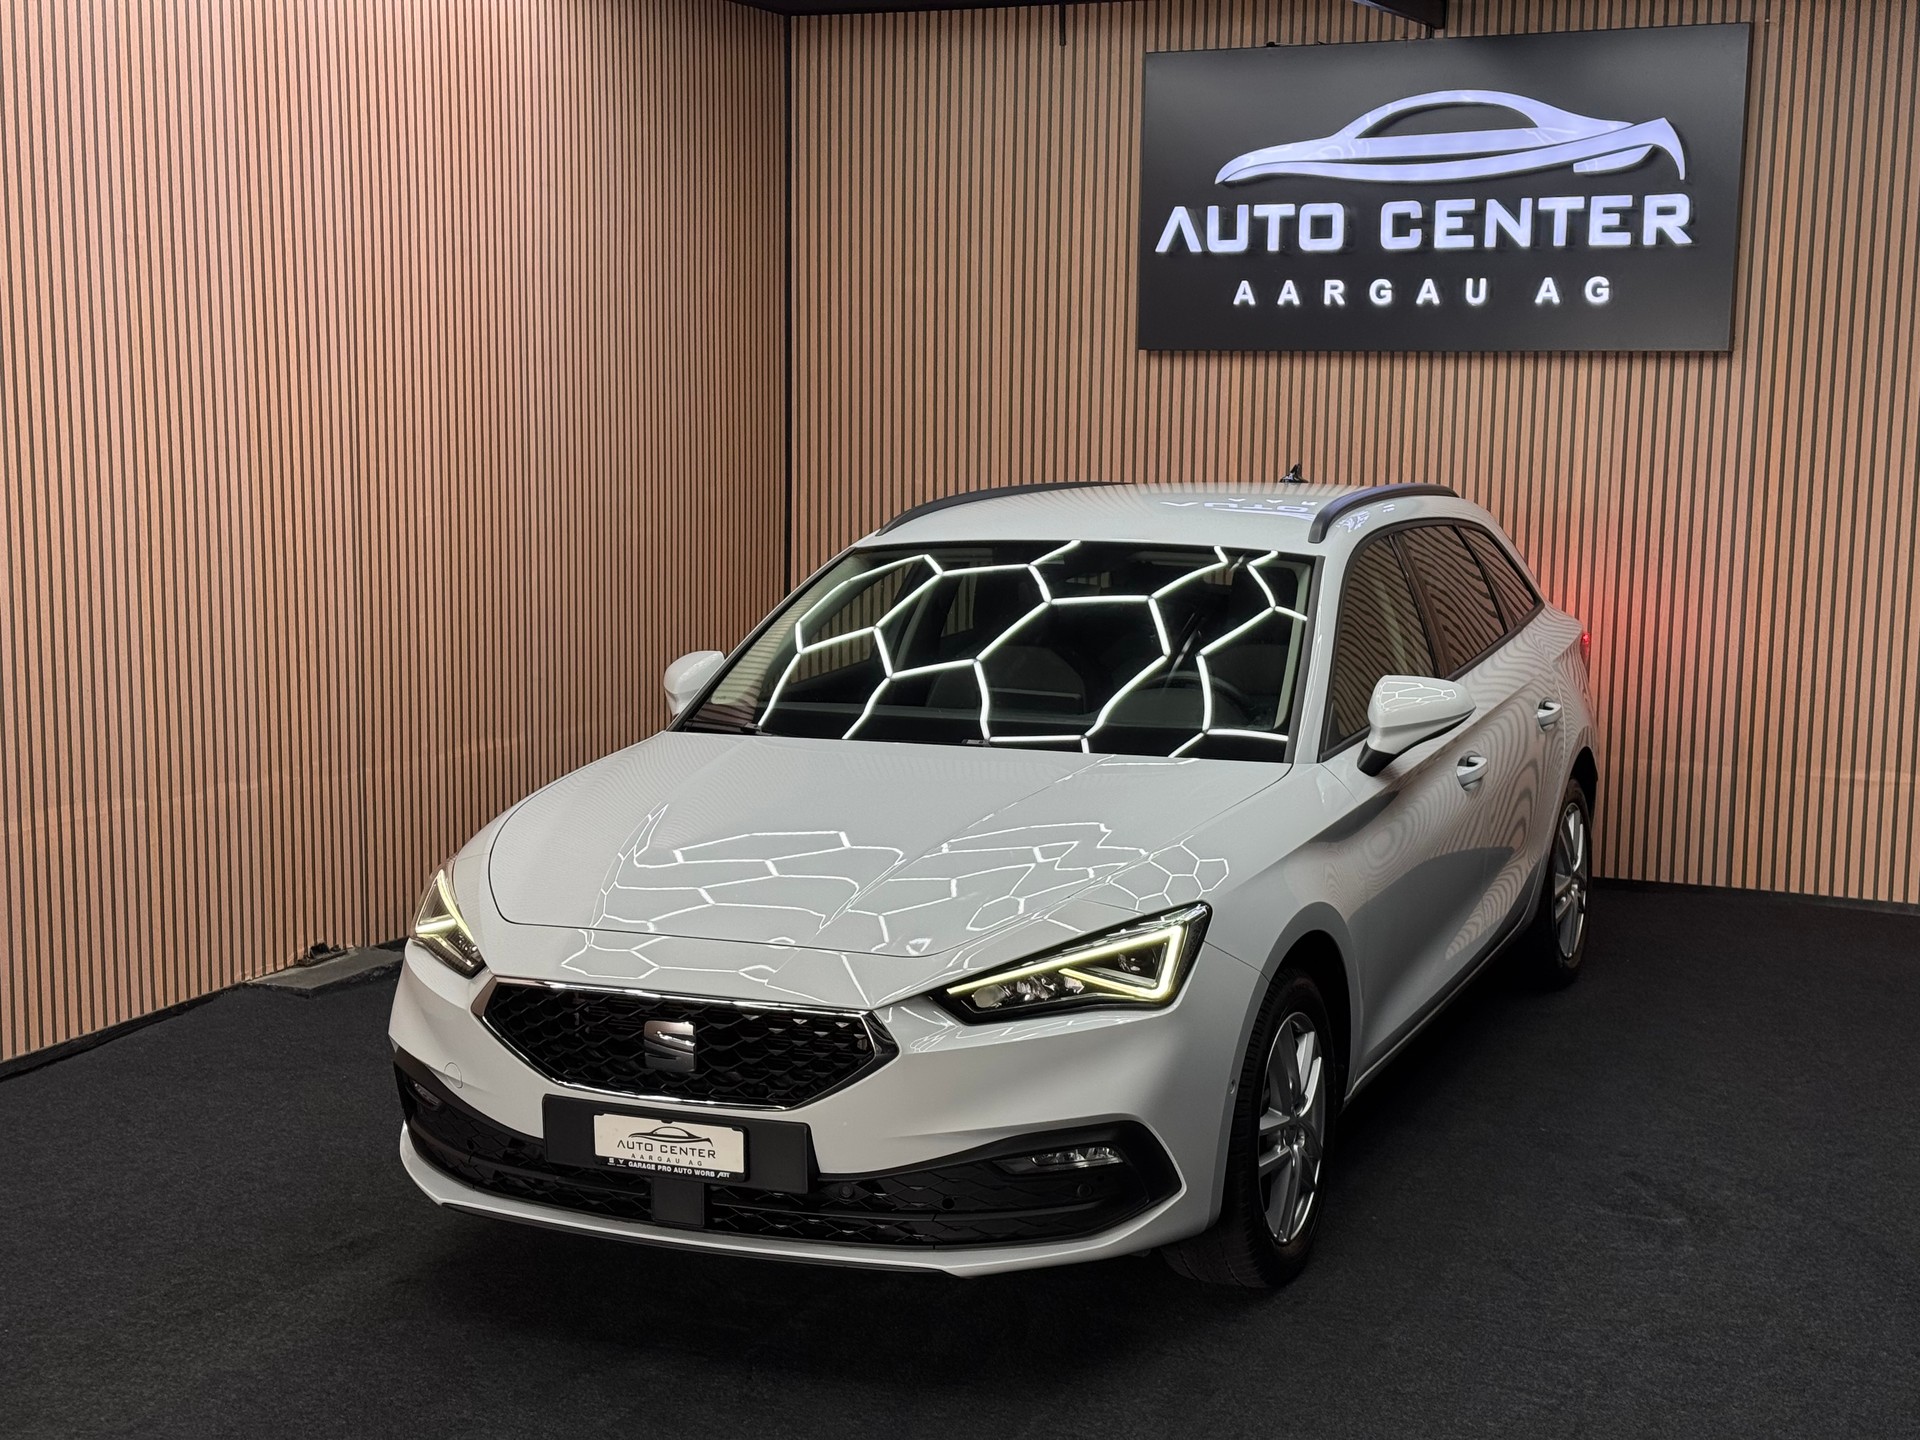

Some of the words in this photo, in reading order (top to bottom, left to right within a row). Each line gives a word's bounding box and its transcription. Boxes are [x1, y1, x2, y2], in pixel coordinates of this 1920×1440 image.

[1155, 202, 1344, 253] AUTO
[1380, 193, 1692, 251] CENTER
[1233, 278, 1488, 306] AARGAU
[1535, 276, 1610, 305] AG
[617, 1139, 654, 1152] AUTO
[659, 1144, 716, 1159] CENTER
[628, 1160, 656, 1171] GARAGE
[657, 1164, 672, 1173] PRO
[673, 1166, 693, 1175] AUTO
[694, 1169, 715, 1178] WORB
[631, 1153, 680, 1164] AARGAU
[688, 1159, 703, 1167] AG
